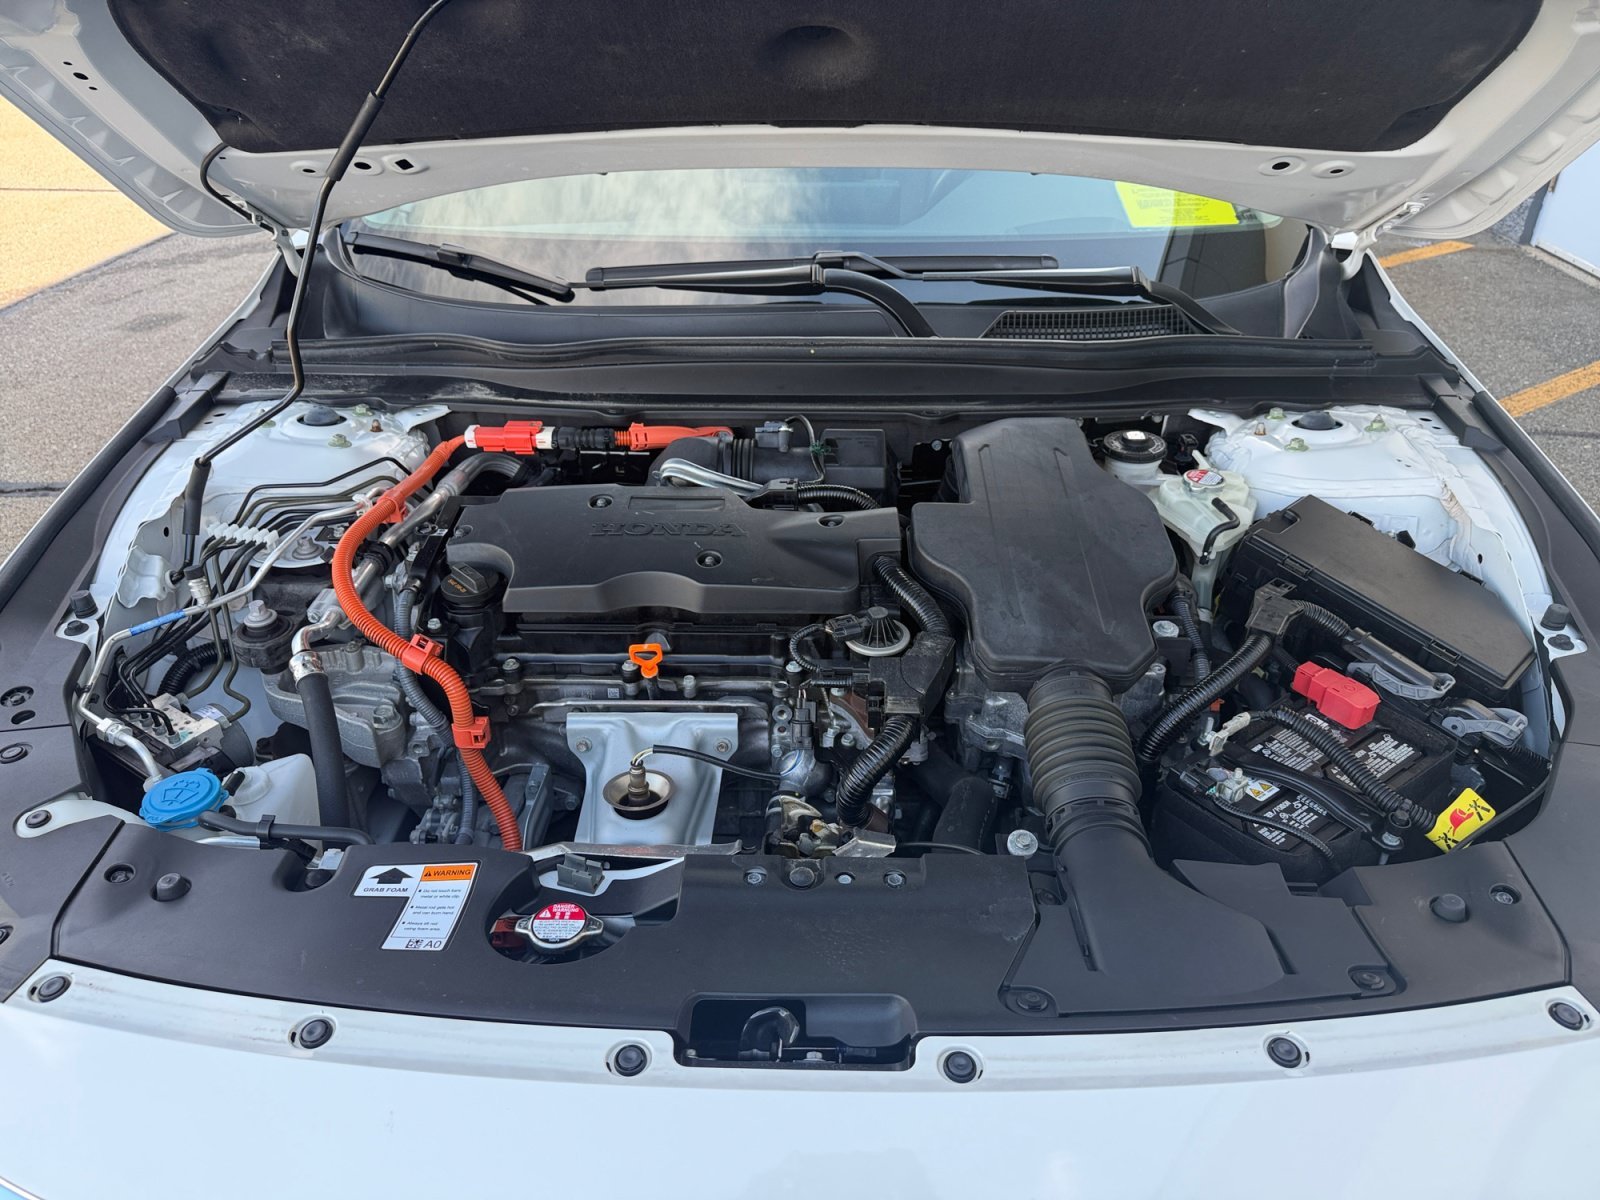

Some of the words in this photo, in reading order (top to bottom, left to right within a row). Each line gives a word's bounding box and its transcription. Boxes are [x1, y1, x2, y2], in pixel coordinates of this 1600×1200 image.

[589, 521, 748, 538] HONDA
[433, 869, 471, 877] WARNING
[423, 940, 442, 949] A0
